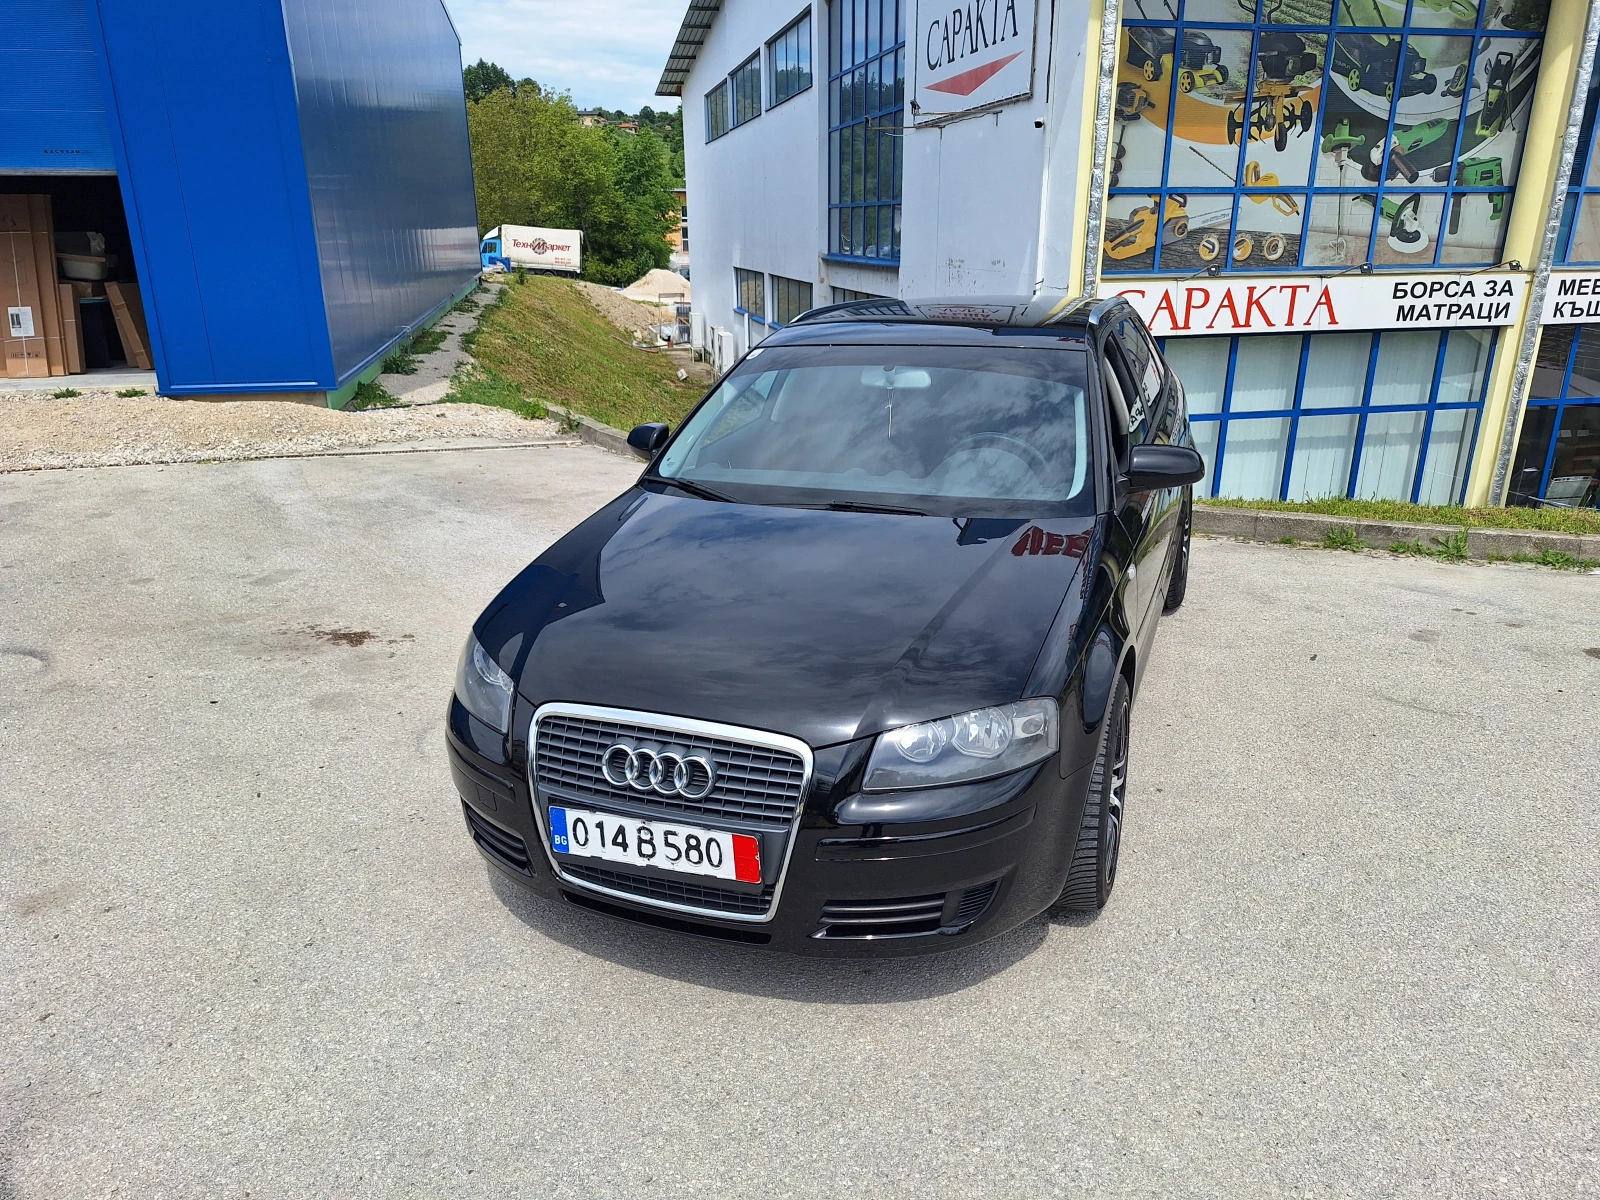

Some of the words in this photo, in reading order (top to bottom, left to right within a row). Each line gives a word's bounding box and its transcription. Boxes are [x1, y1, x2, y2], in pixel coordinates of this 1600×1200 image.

[1392, 280, 1476, 300] БОРСА
[1483, 279, 1514, 297] ЗА
[1395, 301, 1511, 322] МАТРАЦИ
[554, 834, 568, 846] BG
